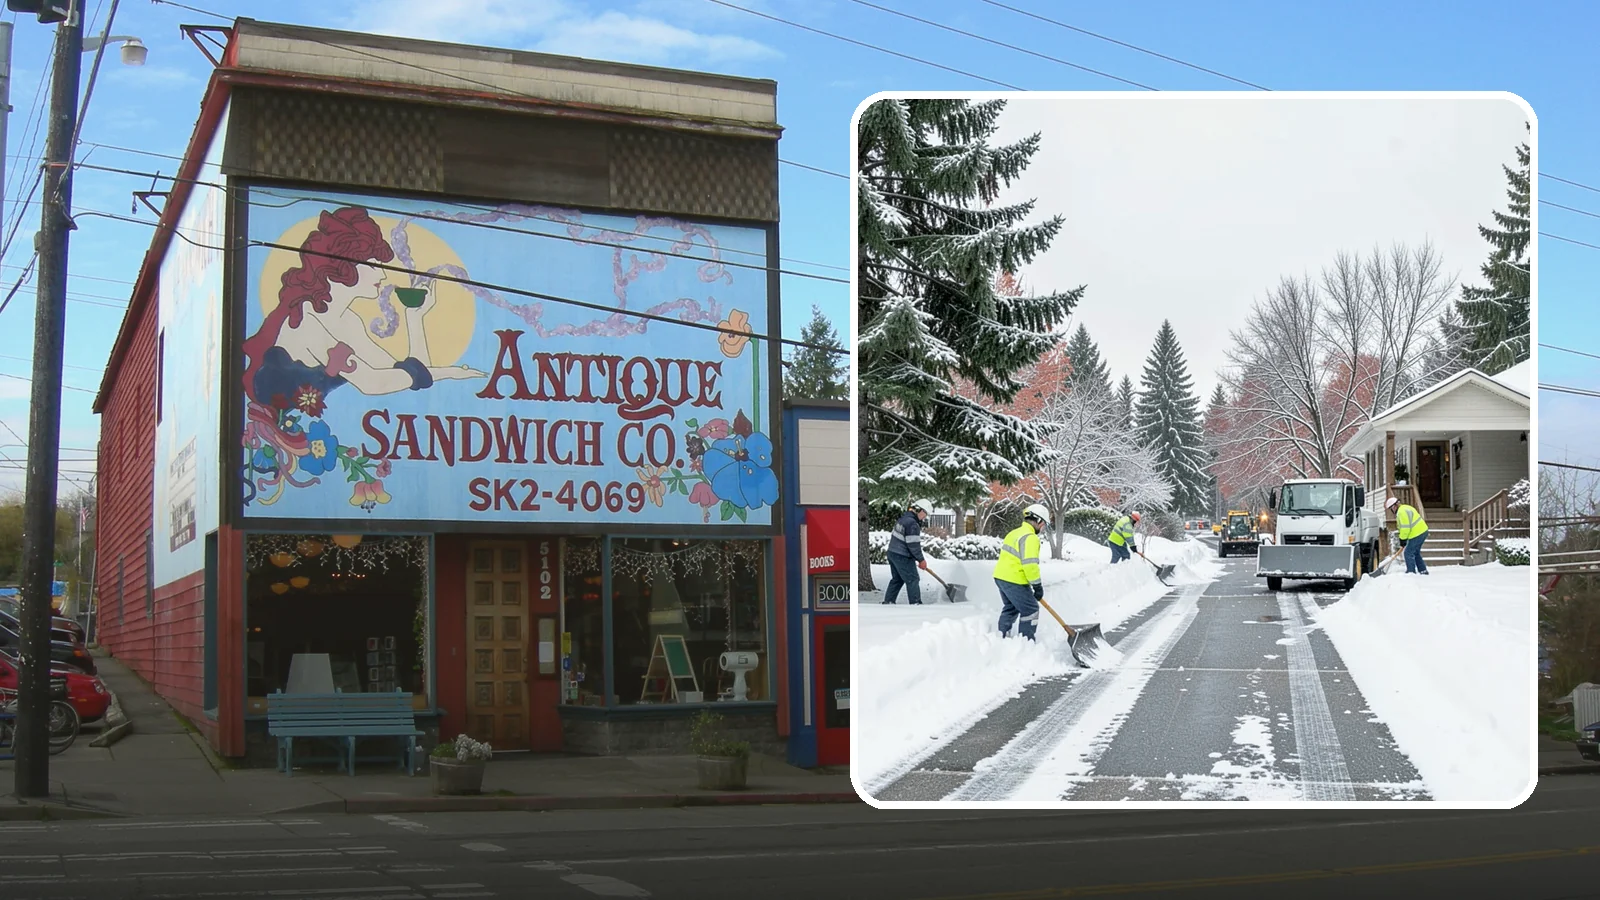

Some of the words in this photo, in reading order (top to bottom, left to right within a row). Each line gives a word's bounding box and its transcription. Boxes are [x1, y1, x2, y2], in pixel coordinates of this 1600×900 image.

[475, 329, 723, 420] ANTIQUE
[361, 409, 605, 467] SANDWICH
[617, 422, 684, 469] CO.
[468, 477, 646, 512] SK2-4069
[540, 541, 551, 600] 5102
[809, 555, 835, 569] BOOKS
